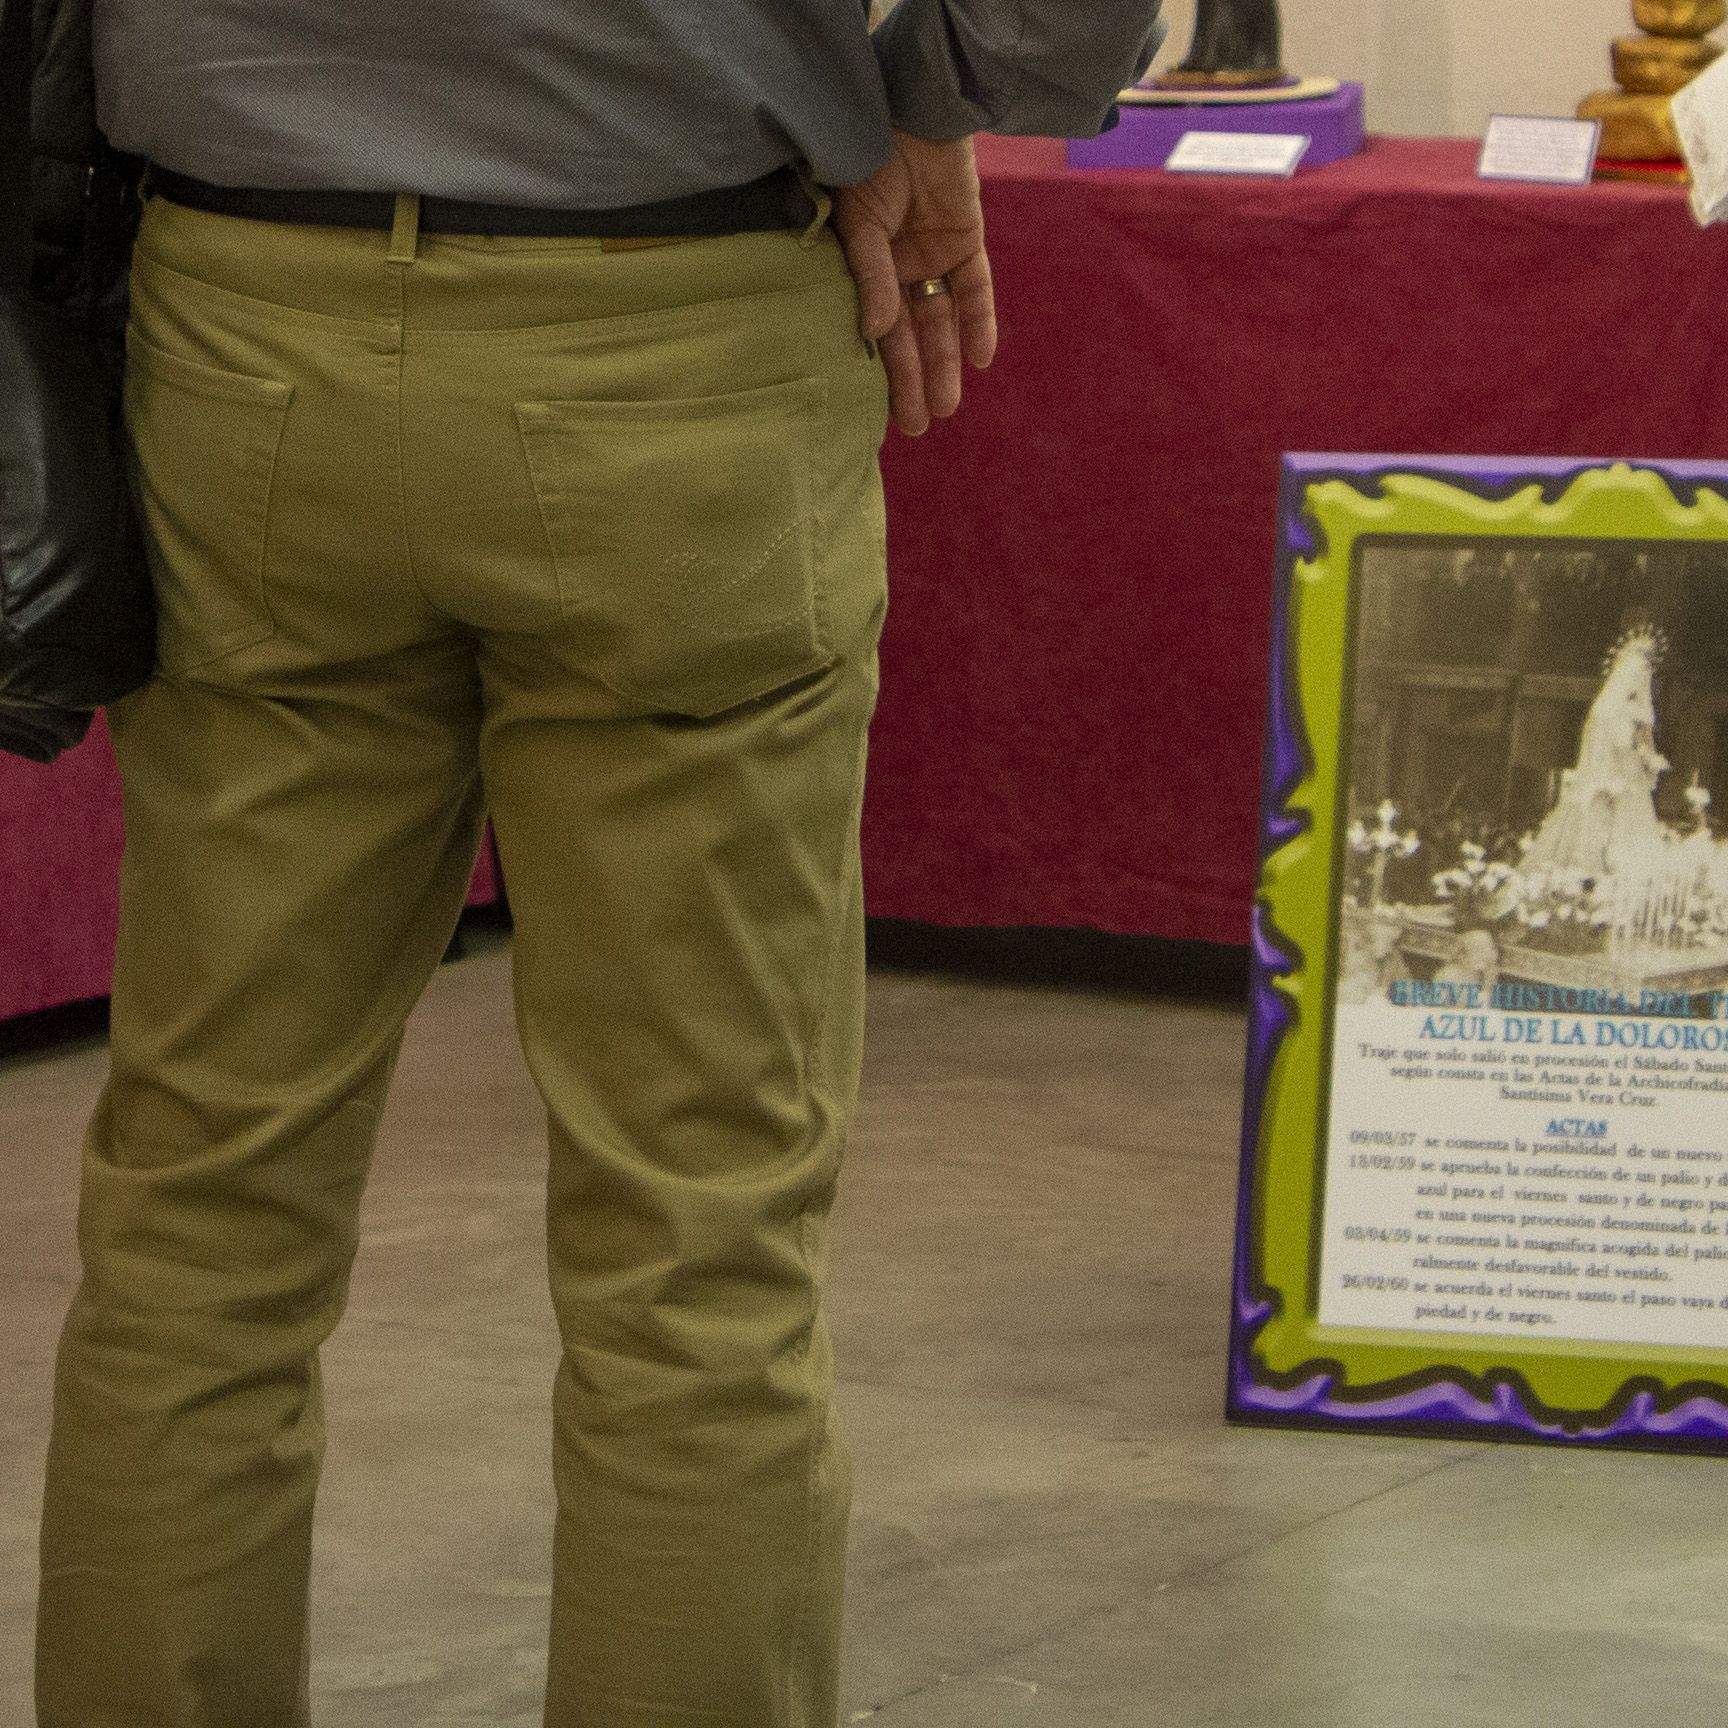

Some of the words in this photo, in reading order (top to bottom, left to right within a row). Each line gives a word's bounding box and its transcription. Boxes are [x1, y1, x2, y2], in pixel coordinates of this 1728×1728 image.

[1390, 980, 1483, 1008] BREVE
[1490, 984, 1632, 1014] HISTORIA
[1640, 989, 1692, 1016] DEL
[1419, 1014, 1496, 1041] AZUL
[1502, 1017, 1542, 1043] DE
[1551, 1020, 1586, 1045] LA
[1358, 1043, 1398, 1060] Traje
[1404, 1050, 1429, 1062] que
[1511, 1053, 1530, 1064] en
[1535, 1051, 1609, 1069] procesión
[1614, 1056, 1628, 1069] el
[1633, 1056, 1689, 1072] Sábado
[1437, 1068, 1485, 1080] consta
[1490, 1071, 1508, 1081] en
[1513, 1069, 1534, 1082] las
[1540, 1071, 1579, 1085] Actas
[1585, 1072, 1605, 1086] de
[1609, 1074, 1622, 1087] la
[1578, 1089, 1613, 1104] Vera
[1546, 1119, 1607, 1138] ACTAS
[1425, 1138, 1440, 1148] se
[1445, 1139, 1509, 1152] comenta
[1515, 1138, 1527, 1152] la
[1533, 1140, 1617, 1157] posibilidad
[1627, 1144, 1646, 1158] de
[1651, 1148, 1670, 1159] un
[1676, 1149, 1723, 1162] nuevo
[1421, 1161, 1434, 1171] se
[1441, 1161, 1501, 1176] aprueba
[1507, 1161, 1519, 1175] la
[1525, 1162, 1607, 1180] confección
[1612, 1167, 1634, 1182] de
[1636, 1172, 1656, 1183] un
[1661, 1170, 1699, 1186] palio
[1704, 1175, 1713, 1188] y
[1417, 1183, 1447, 1196] azul
[1452, 1186, 1485, 1200] para
[1490, 1185, 1505, 1199] el
[1514, 1186, 1568, 1202] viernes
[1578, 1192, 1618, 1204] santo
[1623, 1196, 1632, 1208] y
[1636, 1192, 1654, 1207] de
[1660, 1196, 1705, 1211] negro
[1416, 1209, 1434, 1220] en
[1439, 1210, 1467, 1221] una
[1472, 1212, 1516, 1225] nueva
[1521, 1211, 1595, 1229] procesión
[1601, 1215, 1695, 1234] denominada
[1701, 1220, 1720, 1234] de
[1416, 1233, 1430, 1243] se
[1436, 1235, 1500, 1248] comenta
[1506, 1234, 1518, 1248] la
[1603, 1240, 1659, 1257] acogida
[1665, 1243, 1688, 1258] del
[1413, 1254, 1477, 1270] ralmente
[1484, 1257, 1580, 1276] desfavorable
[1585, 1263, 1610, 1278] del
[1615, 1266, 1672, 1282] vestido.
[1414, 1282, 1429, 1292] se
[1434, 1281, 1493, 1296] acuerda
[1499, 1283, 1512, 1297] el
[1517, 1284, 1571, 1300] viernes
[1577, 1290, 1617, 1303] santo
[1622, 1290, 1636, 1304] el
[1641, 1293, 1676, 1308] paso
[1681, 1297, 1714, 1311] vaya
[1416, 1305, 1467, 1320] piedad
[1472, 1310, 1479, 1323] y
[1484, 1307, 1503, 1322] de
